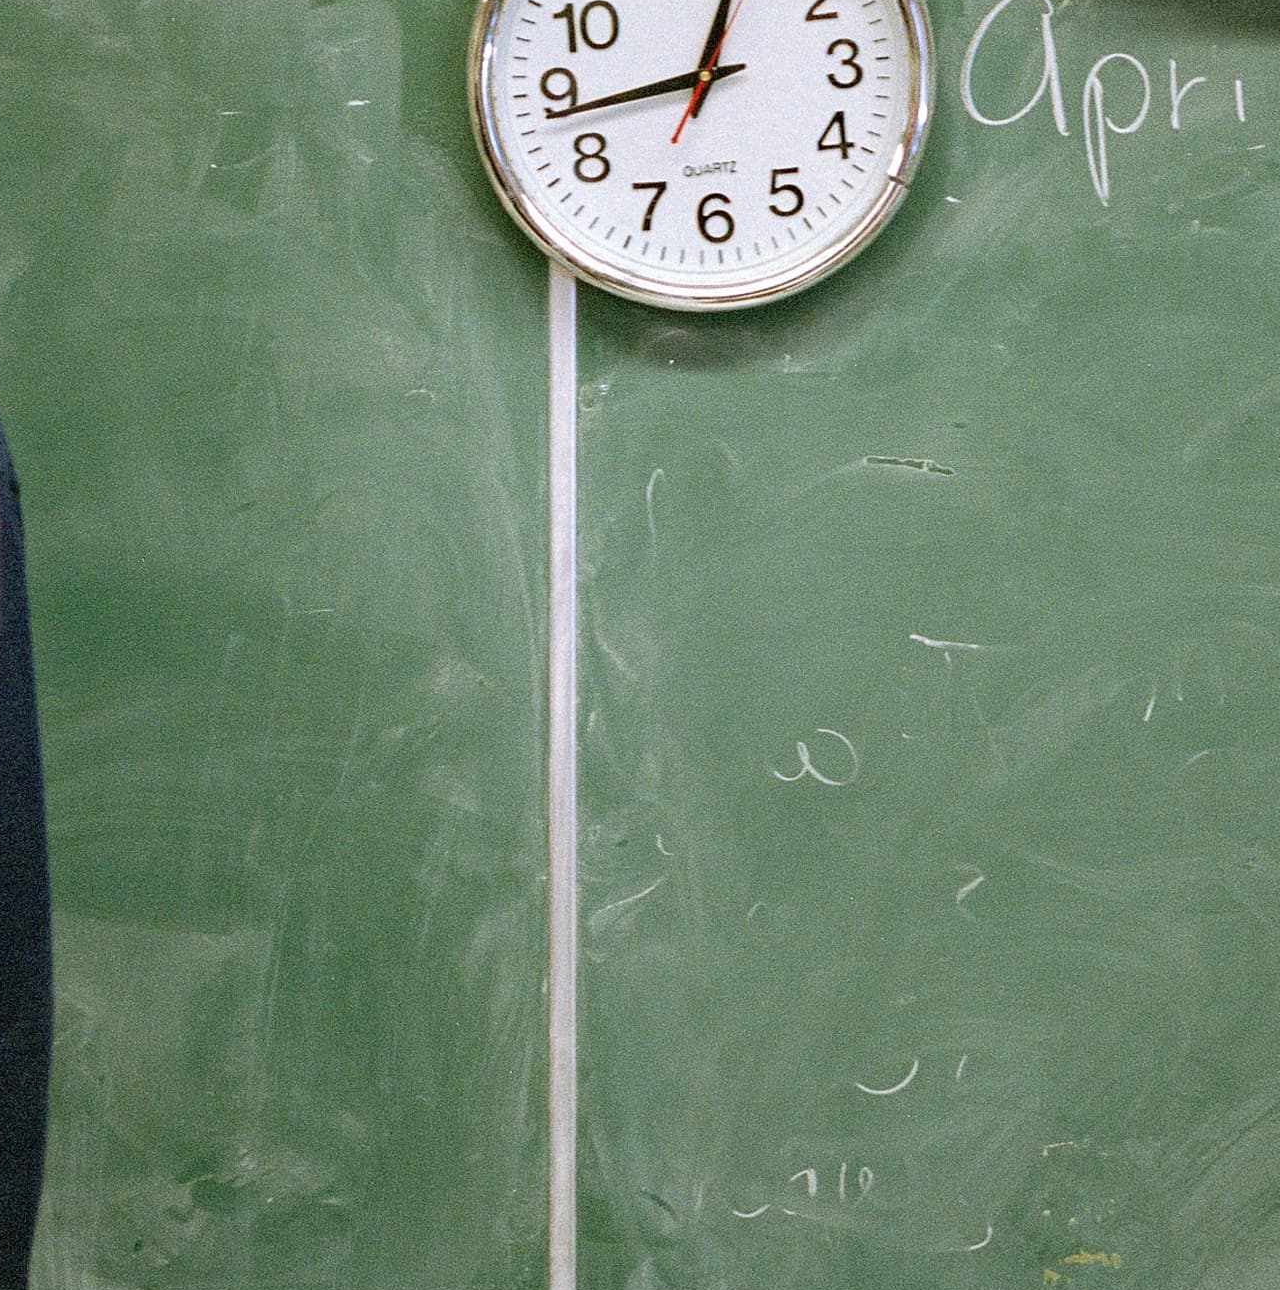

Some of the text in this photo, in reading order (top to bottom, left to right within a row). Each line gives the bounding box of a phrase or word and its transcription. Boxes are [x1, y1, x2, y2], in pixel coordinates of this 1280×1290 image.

[552, 0, 620, 53] 10
[826, 38, 864, 90] 3
[539, 67, 579, 118] 9
[572, 131, 611, 184] 8
[817, 110, 855, 160] 4
[682, 160, 738, 179] QUARTZ
[768, 167, 804, 218] 5
[631, 180, 667, 232] 7
[697, 193, 736, 244] 6
